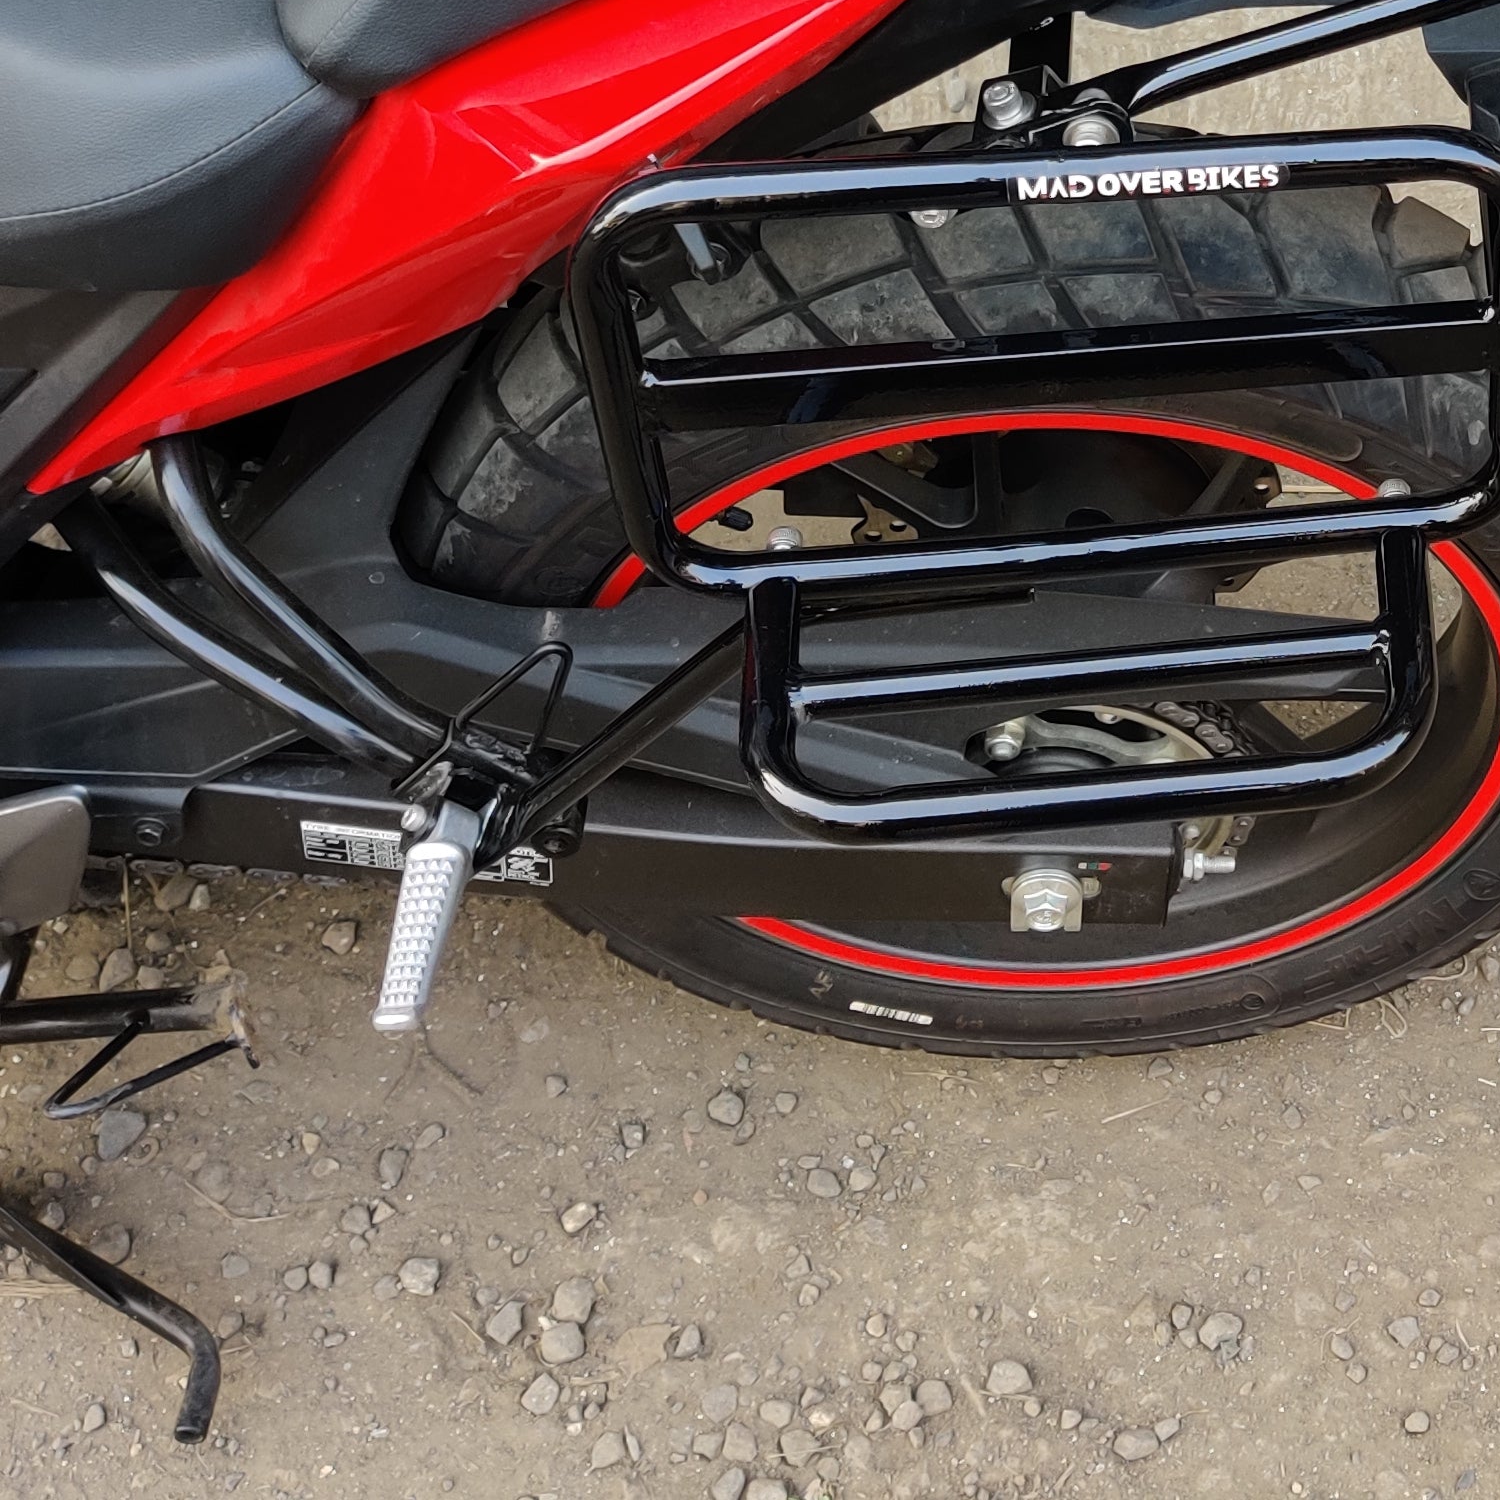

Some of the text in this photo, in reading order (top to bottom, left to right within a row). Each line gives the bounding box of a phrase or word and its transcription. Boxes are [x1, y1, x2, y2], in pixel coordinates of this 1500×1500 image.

[1017, 164, 1280, 201] MAD OVER BIKES
